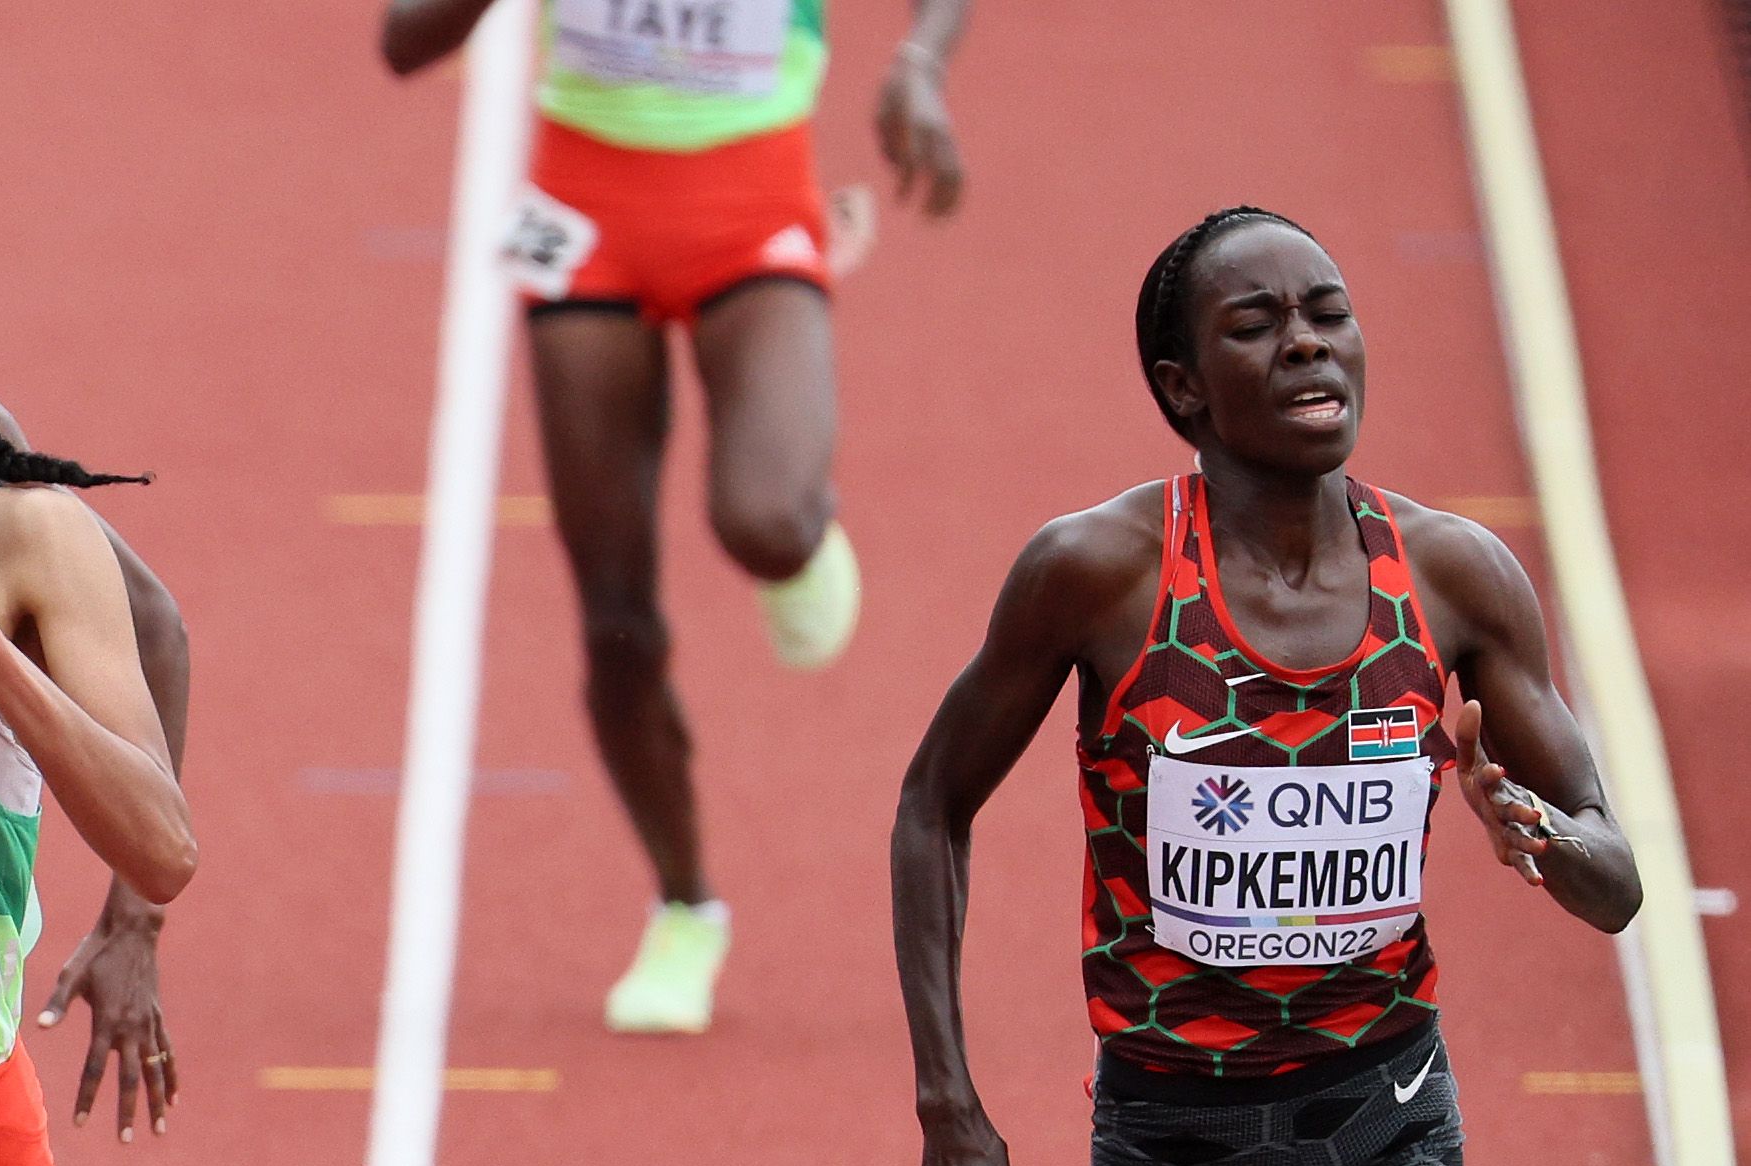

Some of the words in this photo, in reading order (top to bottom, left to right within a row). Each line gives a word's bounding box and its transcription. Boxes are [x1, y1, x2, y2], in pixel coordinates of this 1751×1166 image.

[1267, 779, 1393, 828] QNB
[1161, 840, 1409, 909] KIPKEMBOI
[1188, 927, 1378, 960] OREGON22
